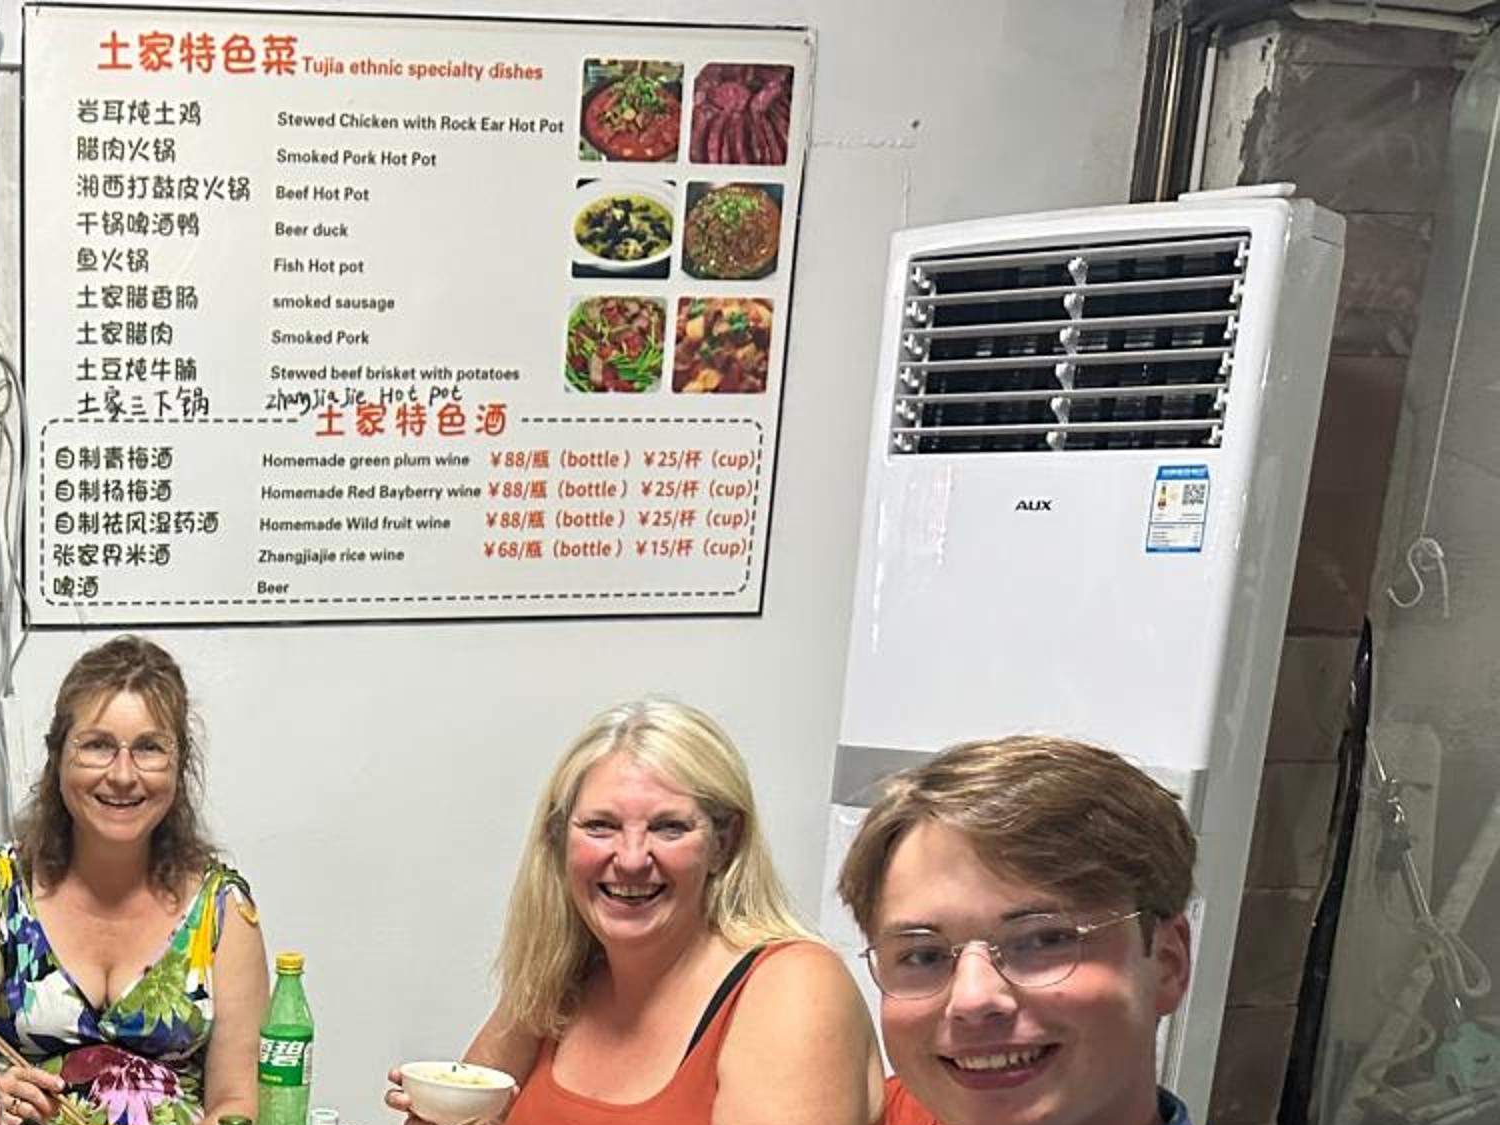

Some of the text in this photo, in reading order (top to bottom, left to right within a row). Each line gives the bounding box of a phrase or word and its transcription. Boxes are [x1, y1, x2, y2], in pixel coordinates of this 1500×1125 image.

[98, 30, 298, 75] 土家特色菜
[301, 57, 543, 81] Tujia ethnic specialty dishes
[77, 99, 202, 126] 岩耳炖土鸡
[277, 112, 564, 133] Stewed Chicken with Rock Ear Hot Pot
[77, 136, 176, 163] 腊肉火锅
[276, 149, 437, 166] Smoked Pork Hot Pot
[76, 174, 250, 201] 湘西打鼓皮火锅
[276, 186, 370, 201] Beef Hot Pot
[76, 211, 201, 238] 干锅啤酒鸭
[275, 222, 348, 237] Beer duck
[76, 247, 149, 272] 鱼火锅
[273, 258, 364, 275] Fish Hot pot
[76, 285, 199, 310] 土家腊香肠
[272, 295, 395, 312] smoked sausage
[76, 321, 173, 346] 土家腊肉
[271, 330, 369, 345] Smoked Pork
[76, 357, 197, 382] 土豆炖牛腩
[270, 366, 520, 383] Stewed beef brisket with potatoes
[379, 386, 418, 406] Hot
[315, 402, 508, 437] 土家特色酒
[55, 445, 173, 470] 自制青梅酒
[262, 453, 469, 470] Homemade green plum wine
[261, 485, 481, 501] Homemade Red Bayberry wine
[1015, 500, 1052, 511] AUX
[55, 511, 219, 535] 自制祛风湿药酒
[259, 516, 451, 532] Homemade Wild fruit wine
[53, 543, 171, 567] 张家界米酒
[258, 548, 404, 565] Zhangjiajie rice wine
[53, 576, 99, 599] 啤酒
[257, 581, 289, 595] Beer
